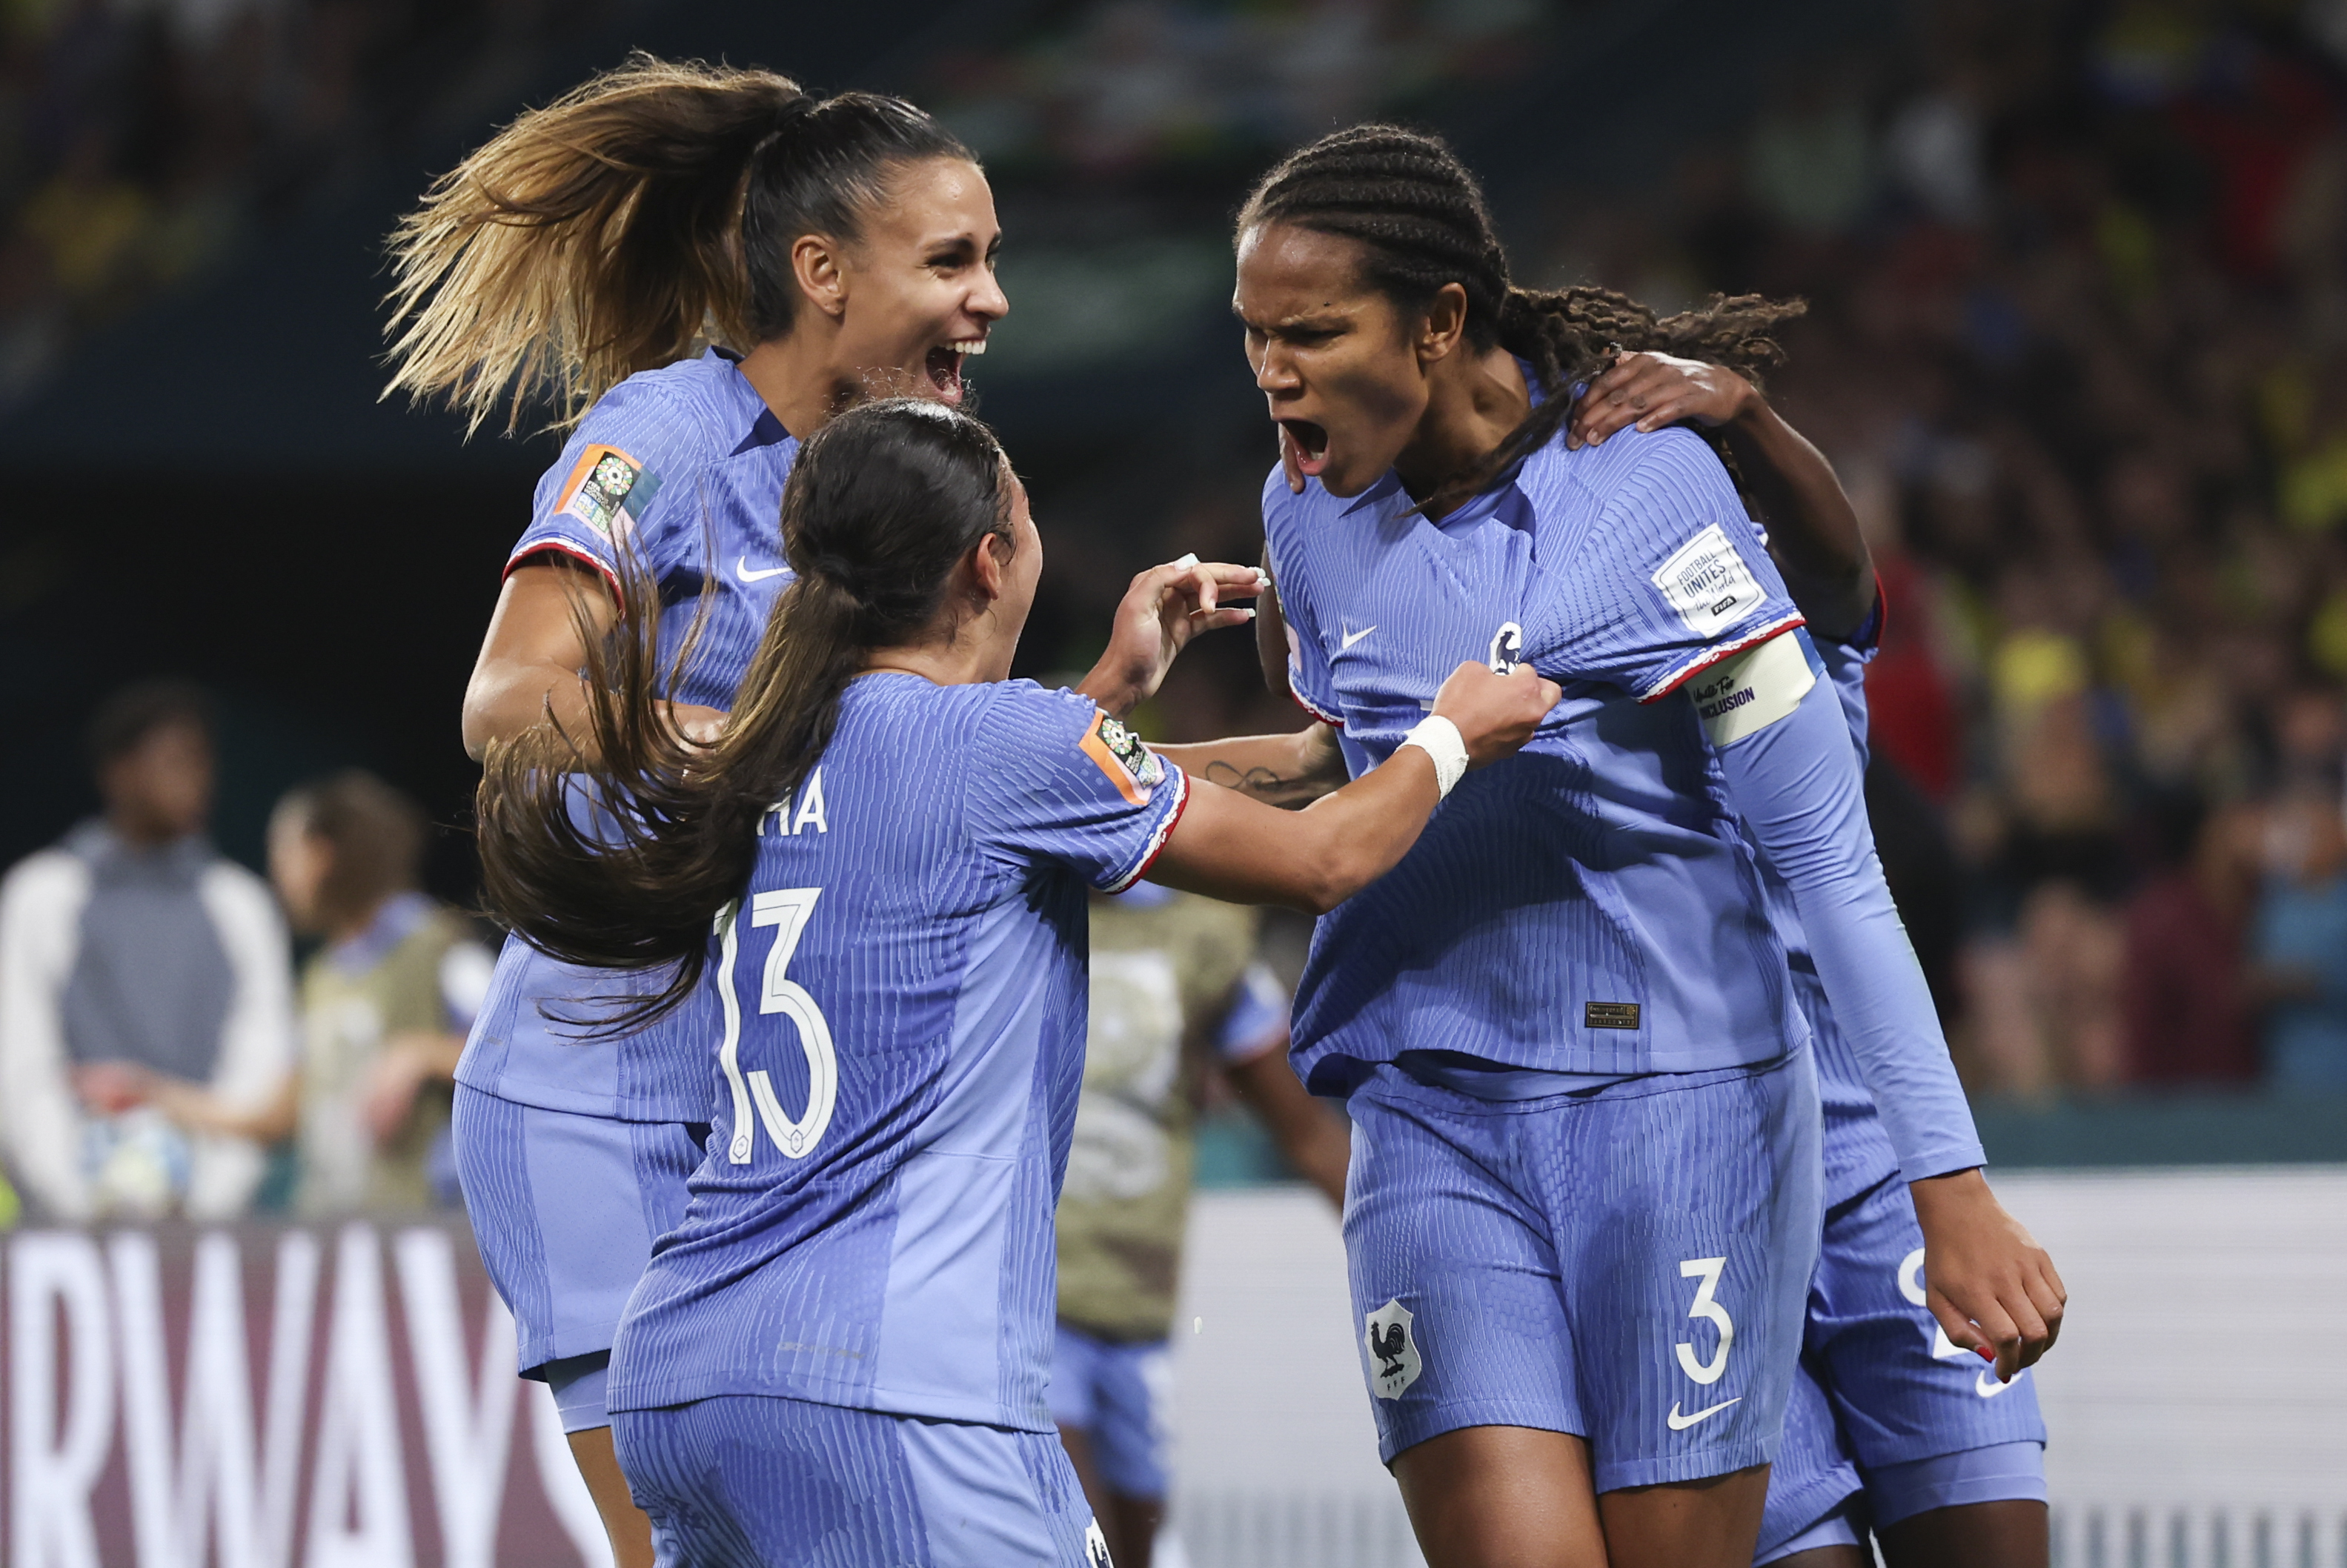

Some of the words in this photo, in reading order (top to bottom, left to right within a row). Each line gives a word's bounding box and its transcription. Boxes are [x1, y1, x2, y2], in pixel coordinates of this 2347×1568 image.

[1676, 549, 1716, 585] FOOTBALL
[1683, 559, 1726, 598] UNITES
[1706, 570, 1736, 600] World
[1713, 597, 1734, 614] FIFA
[713, 887, 838, 1165] 13
[1675, 1256, 1733, 1385] 3
[6, 1223, 617, 1568] RWAY
